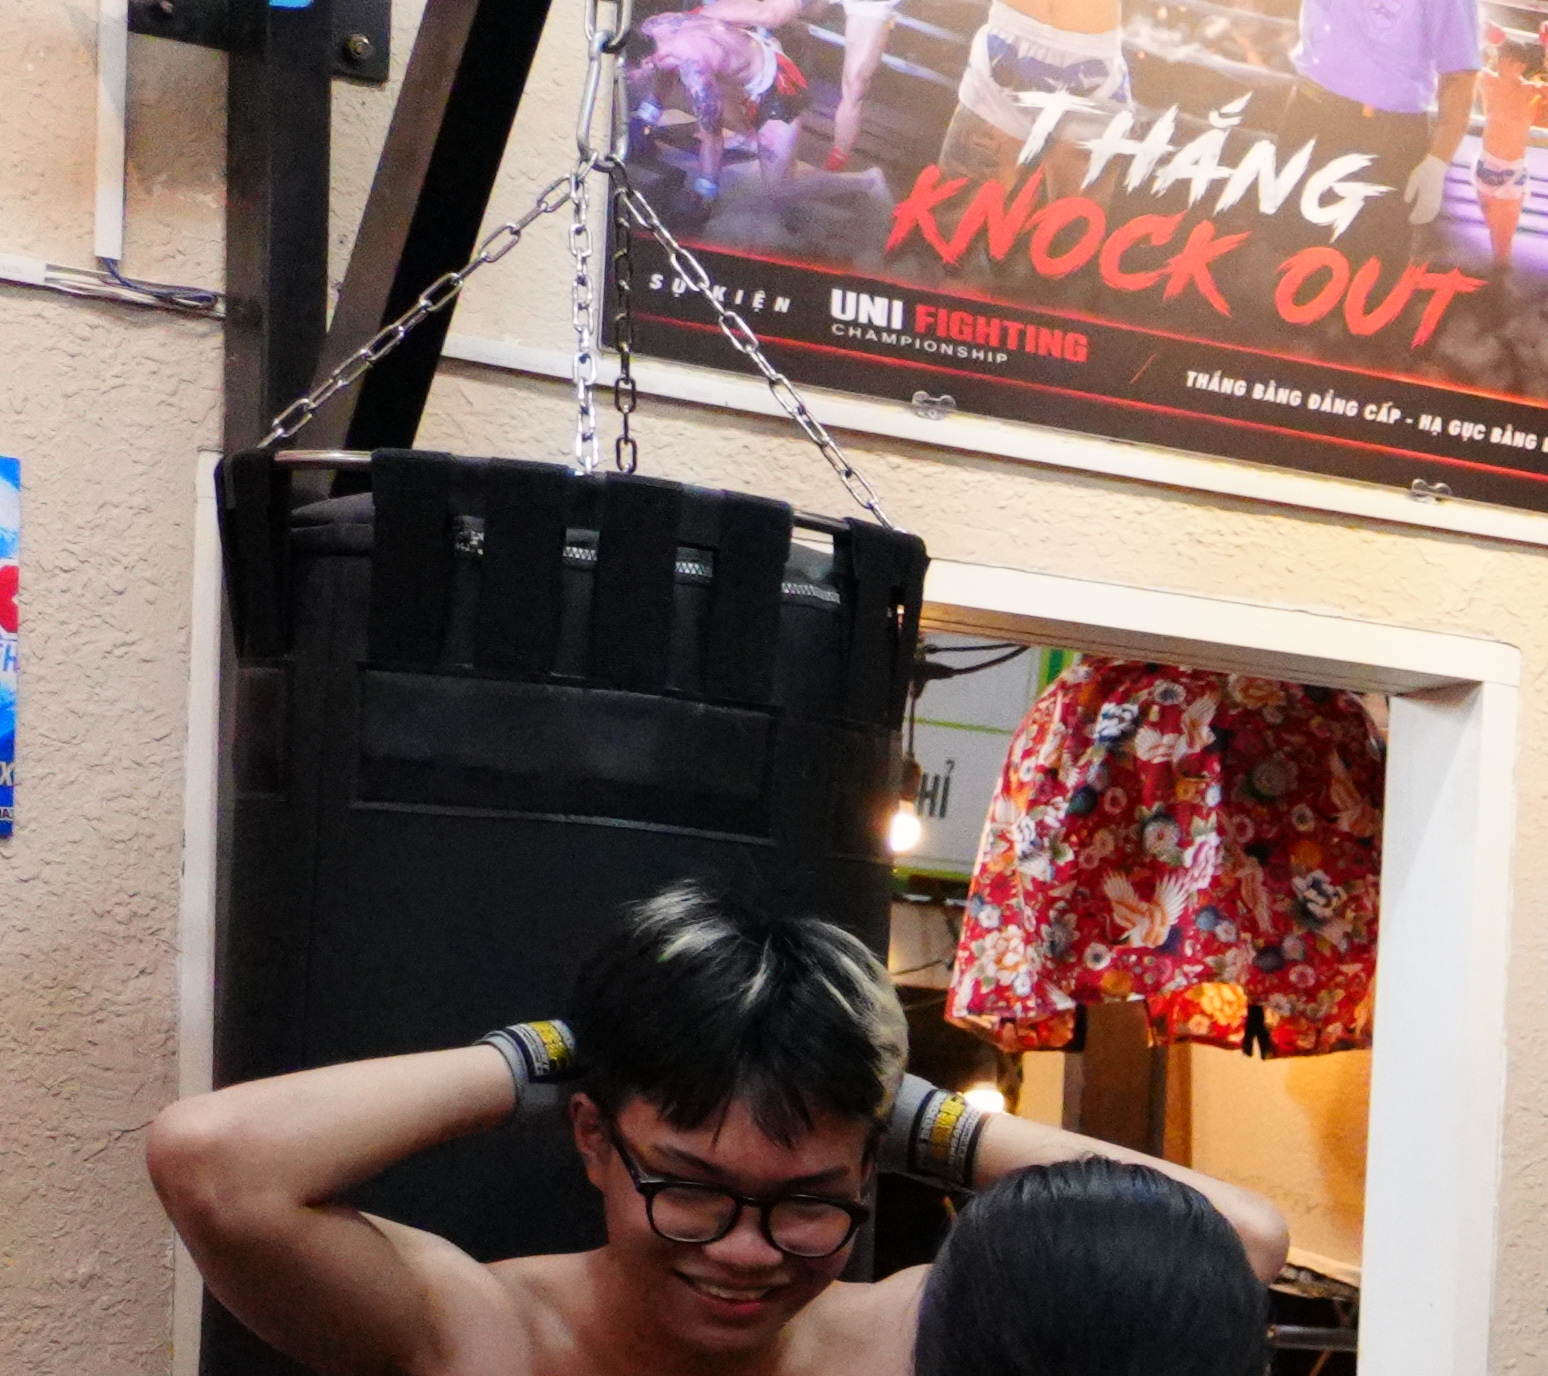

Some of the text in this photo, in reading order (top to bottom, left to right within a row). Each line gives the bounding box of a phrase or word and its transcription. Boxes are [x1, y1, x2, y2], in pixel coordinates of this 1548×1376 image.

[1006, 90, 1397, 243] THẮNG
[884, 166, 1488, 349] KNOCK OUT
[711, 283, 791, 314] KIỆN
[830, 288, 1089, 363] UNI FIGHTING
[831, 323, 1009, 364] CHAMPIONSHIP
[1186, 370, 1247, 397] THẮNG
[1252, 379, 1302, 407] BẰNG
[1363, 401, 1402, 424] CẤP
[1418, 414, 1442, 436] HẠ
[1447, 419, 1487, 442] GỤC
[1489, 423, 1538, 450] BẰNG
